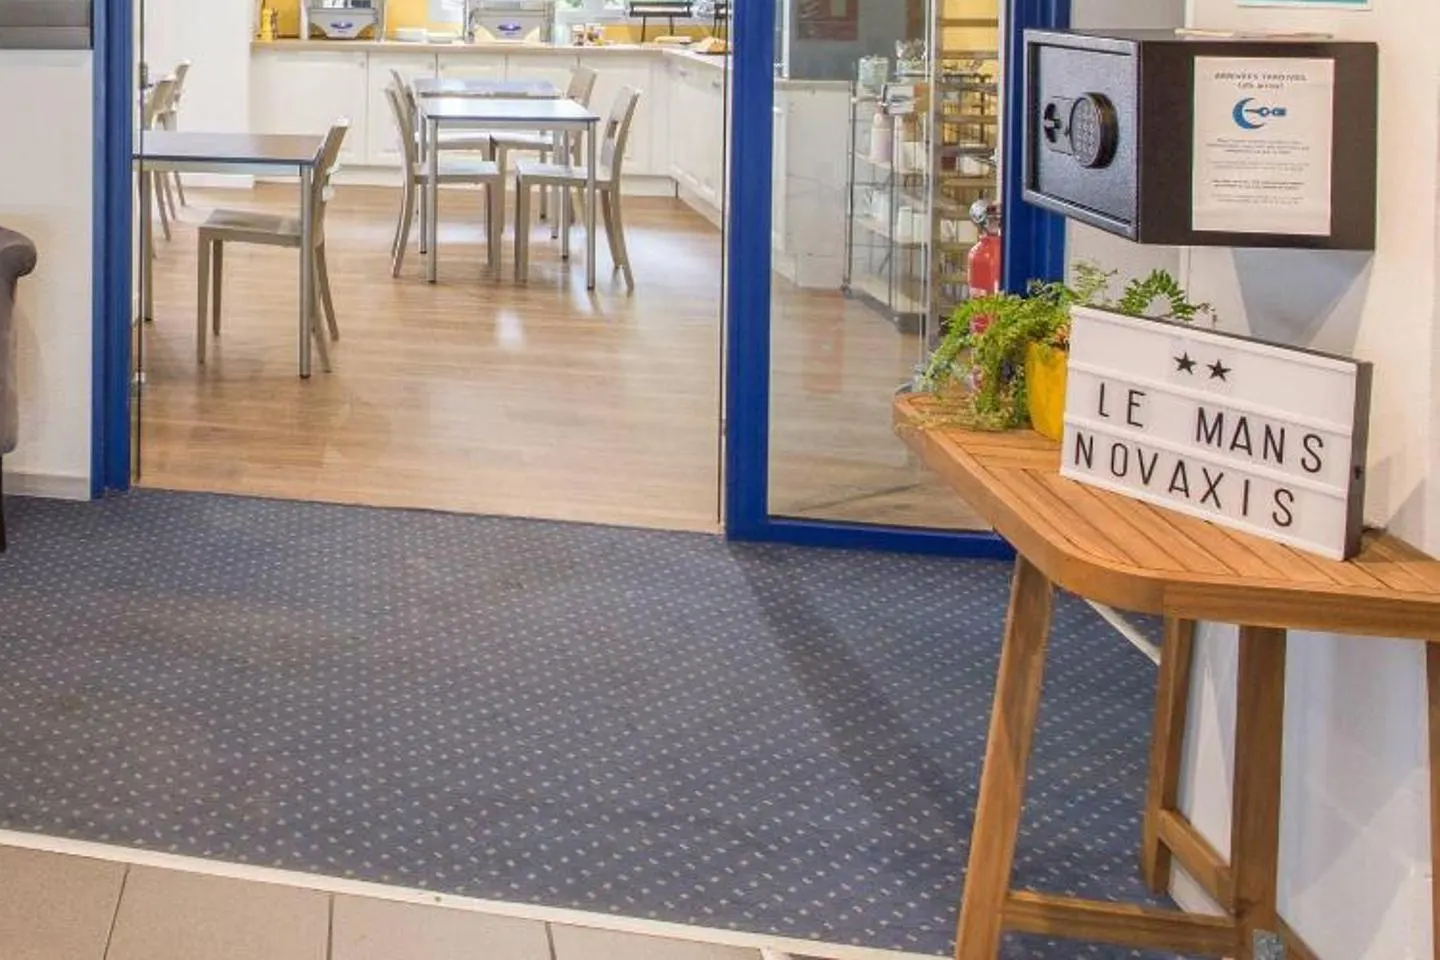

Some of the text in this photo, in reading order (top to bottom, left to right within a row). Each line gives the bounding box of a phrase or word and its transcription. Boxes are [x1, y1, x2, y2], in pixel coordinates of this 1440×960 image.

[1098, 382, 1325, 474] LE MANS
[1074, 432, 1296, 528] NOVAXIS
